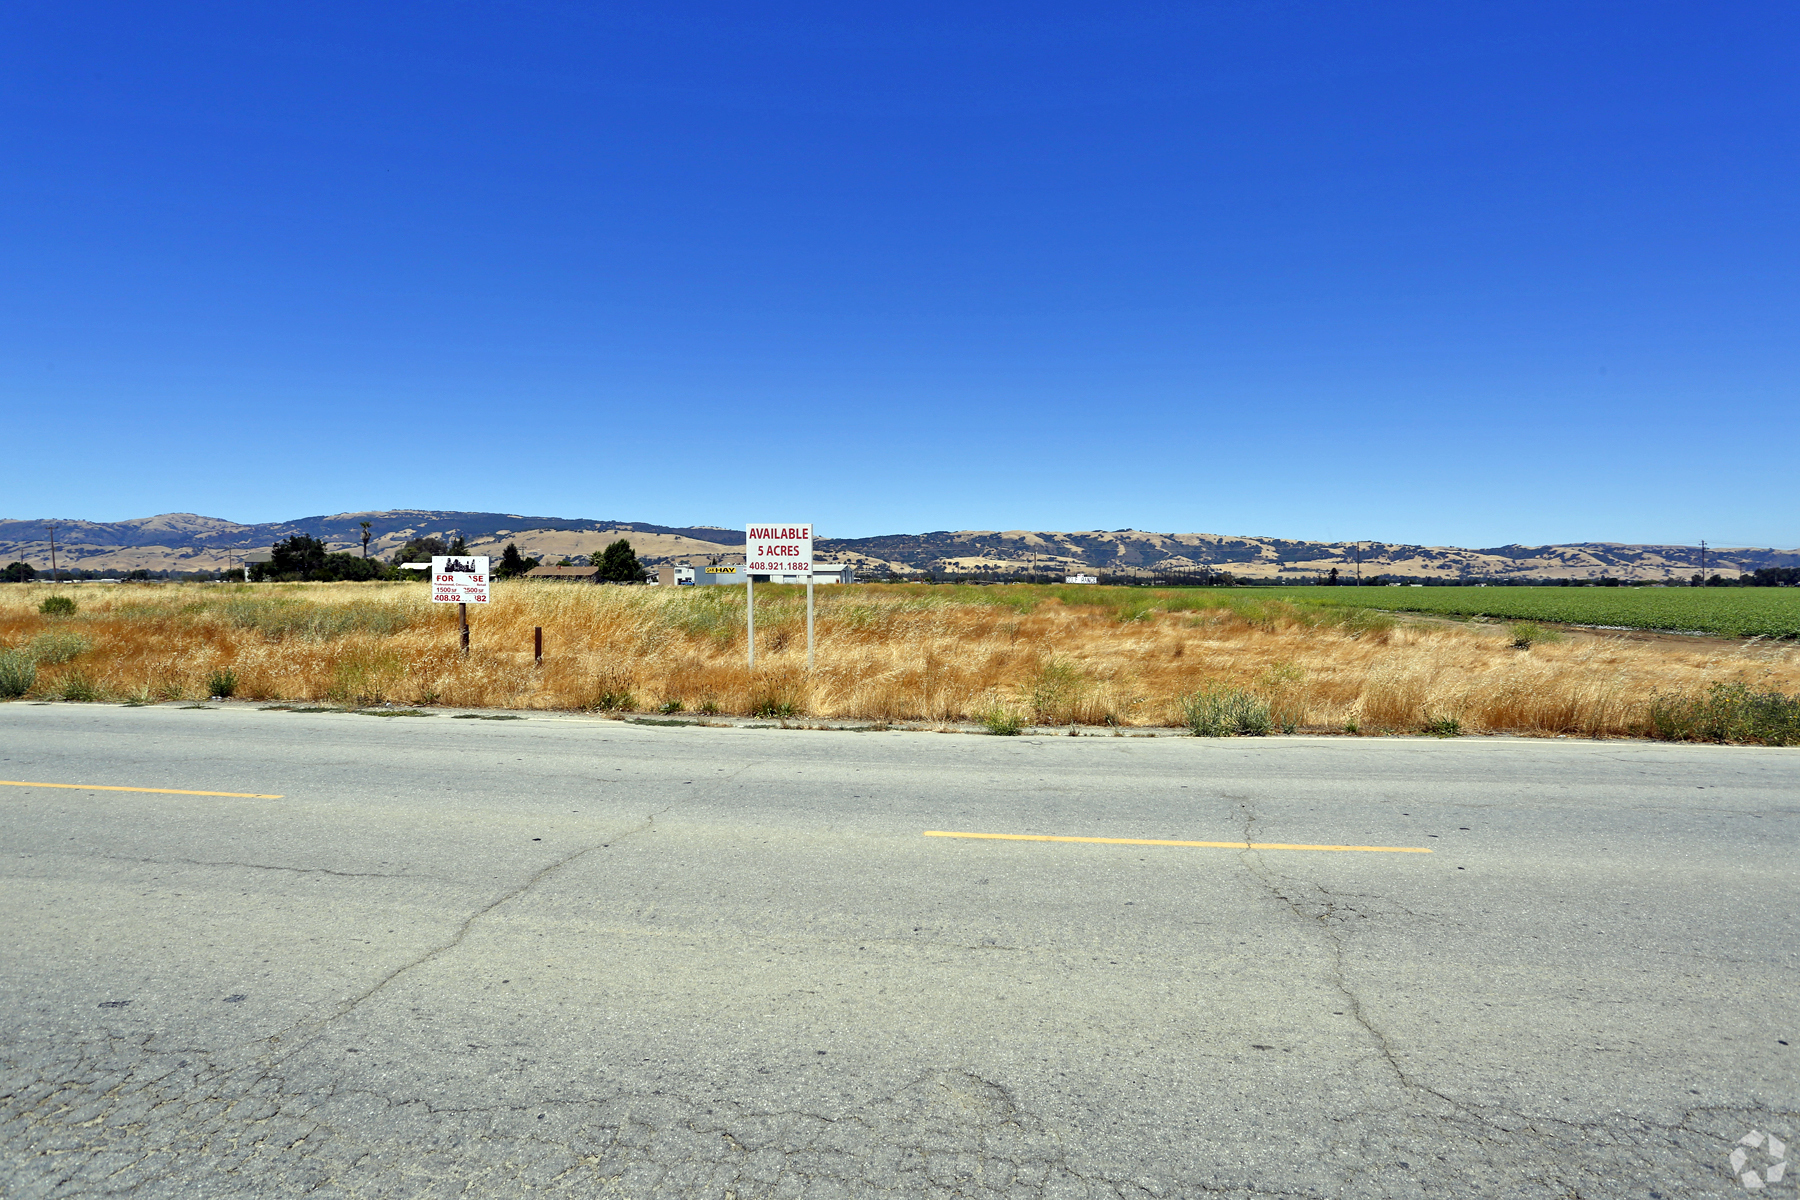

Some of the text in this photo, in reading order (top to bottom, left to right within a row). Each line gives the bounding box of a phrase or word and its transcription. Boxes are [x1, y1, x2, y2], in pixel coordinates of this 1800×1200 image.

[749, 528, 808, 539] AVAILABLE
[758, 545, 799, 556] 5 ACRES
[749, 562, 808, 570] 408.921.1882
